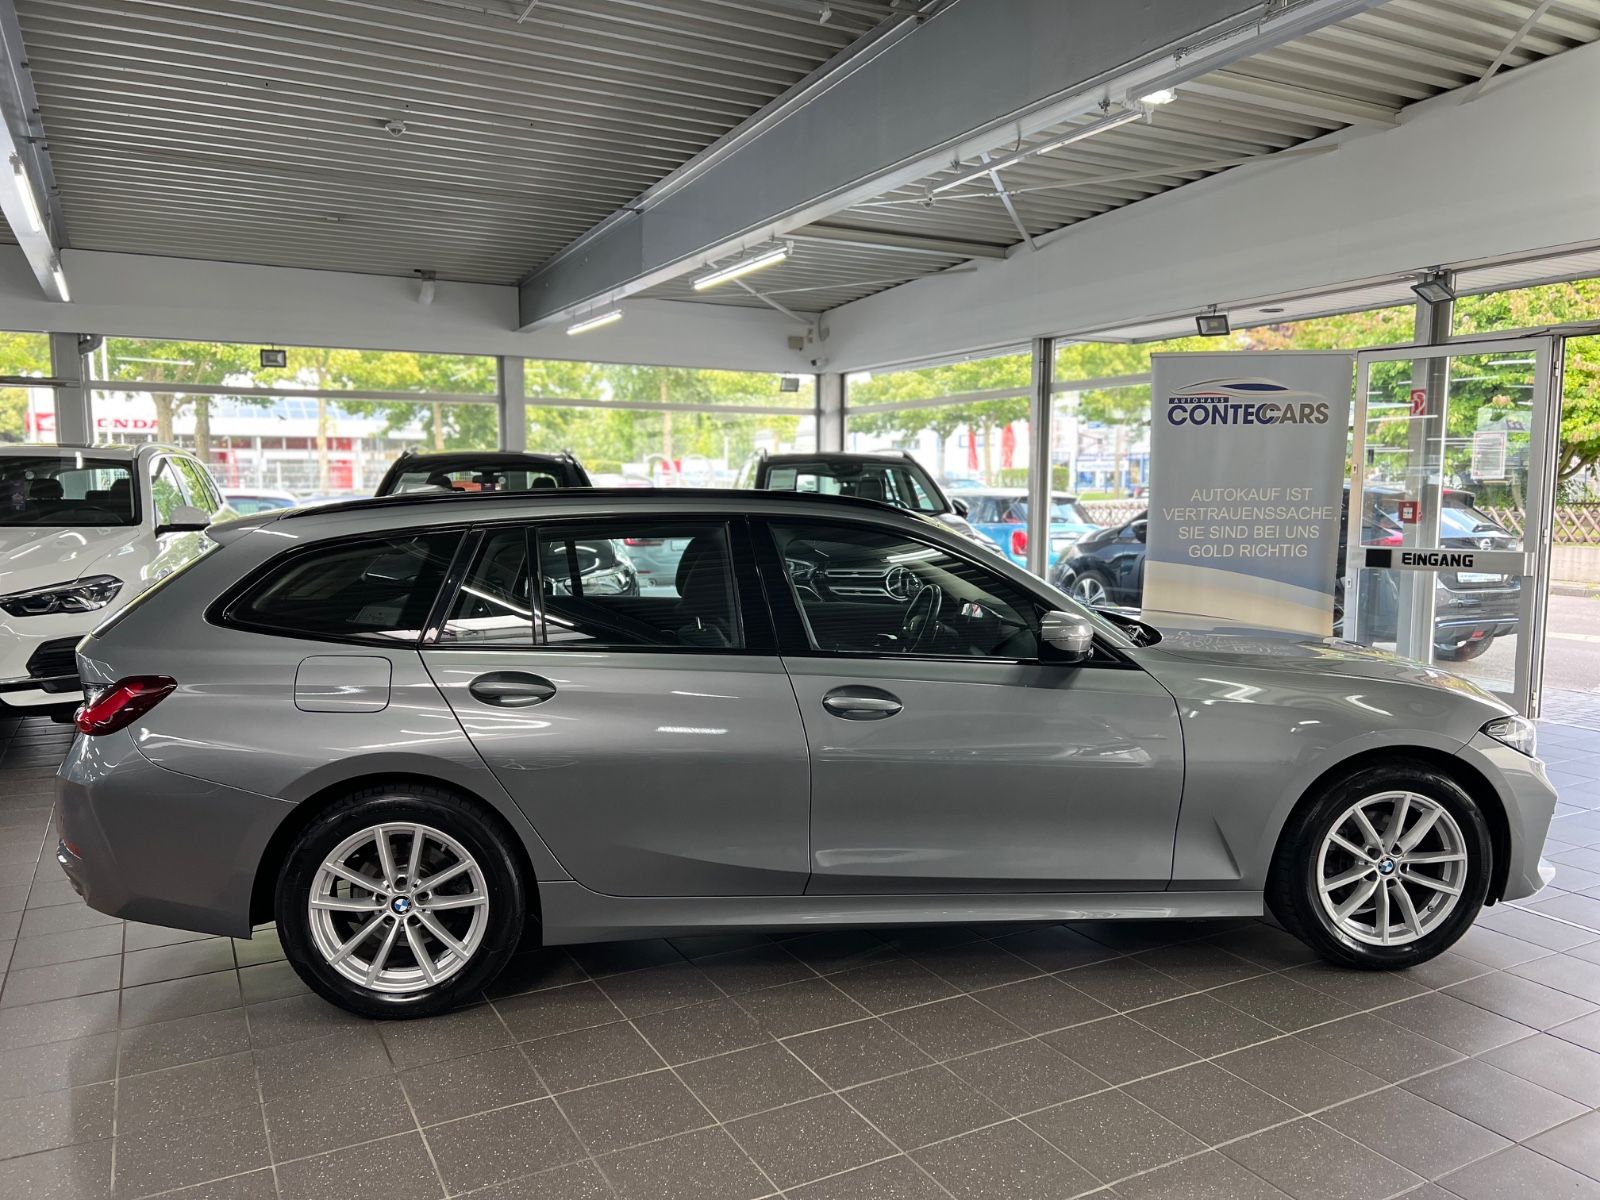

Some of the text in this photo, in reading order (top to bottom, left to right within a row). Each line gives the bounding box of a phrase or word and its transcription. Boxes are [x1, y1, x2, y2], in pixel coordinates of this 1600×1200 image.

[1191, 488, 1313, 502] AUTOKAUF IST
[1163, 507, 1338, 521] VERTRAUENSSACHE,
[1178, 526, 1320, 539] SIE SIND BEI UNS
[1188, 544, 1308, 558] GOLD RICHTIG
[1402, 553, 1474, 567] EINGANG
